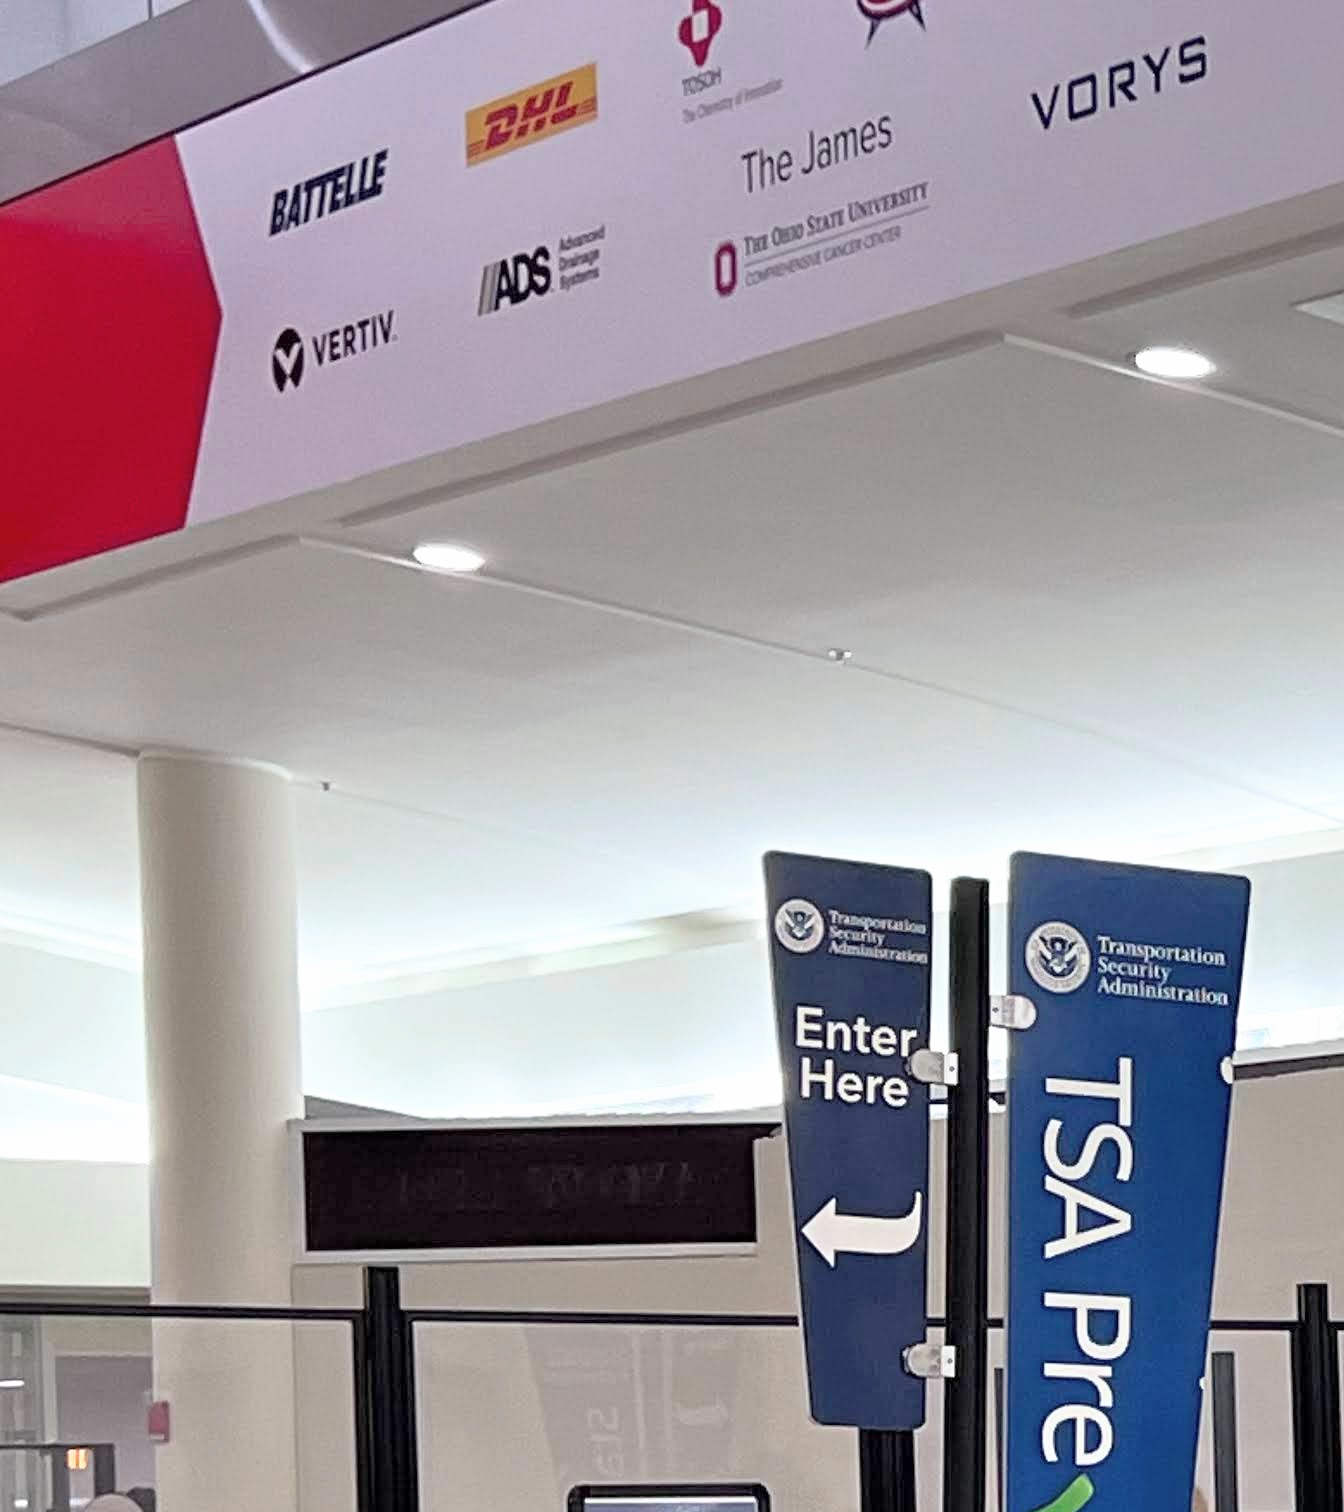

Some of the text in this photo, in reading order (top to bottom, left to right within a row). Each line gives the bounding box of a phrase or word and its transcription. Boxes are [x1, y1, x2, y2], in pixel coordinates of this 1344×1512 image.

[1031, 35, 1208, 130] VORYS
[485, 81, 577, 150] DHL
[741, 114, 893, 193] The James
[269, 148, 389, 237] BATTELLE
[494, 246, 551, 312] ADS
[312, 310, 395, 367] VERTIV
[828, 909, 926, 935] Transportation
[829, 925, 886, 947] Security
[828, 940, 928, 964] Administration
[1097, 934, 1226, 966] Transportation
[1097, 956, 1173, 984] Security
[1097, 976, 1229, 1006] Administration
[793, 1005, 918, 1057] Enter
[800, 1058, 910, 1108] Here
[1042, 1056, 1134, 1464] TSA Pre
